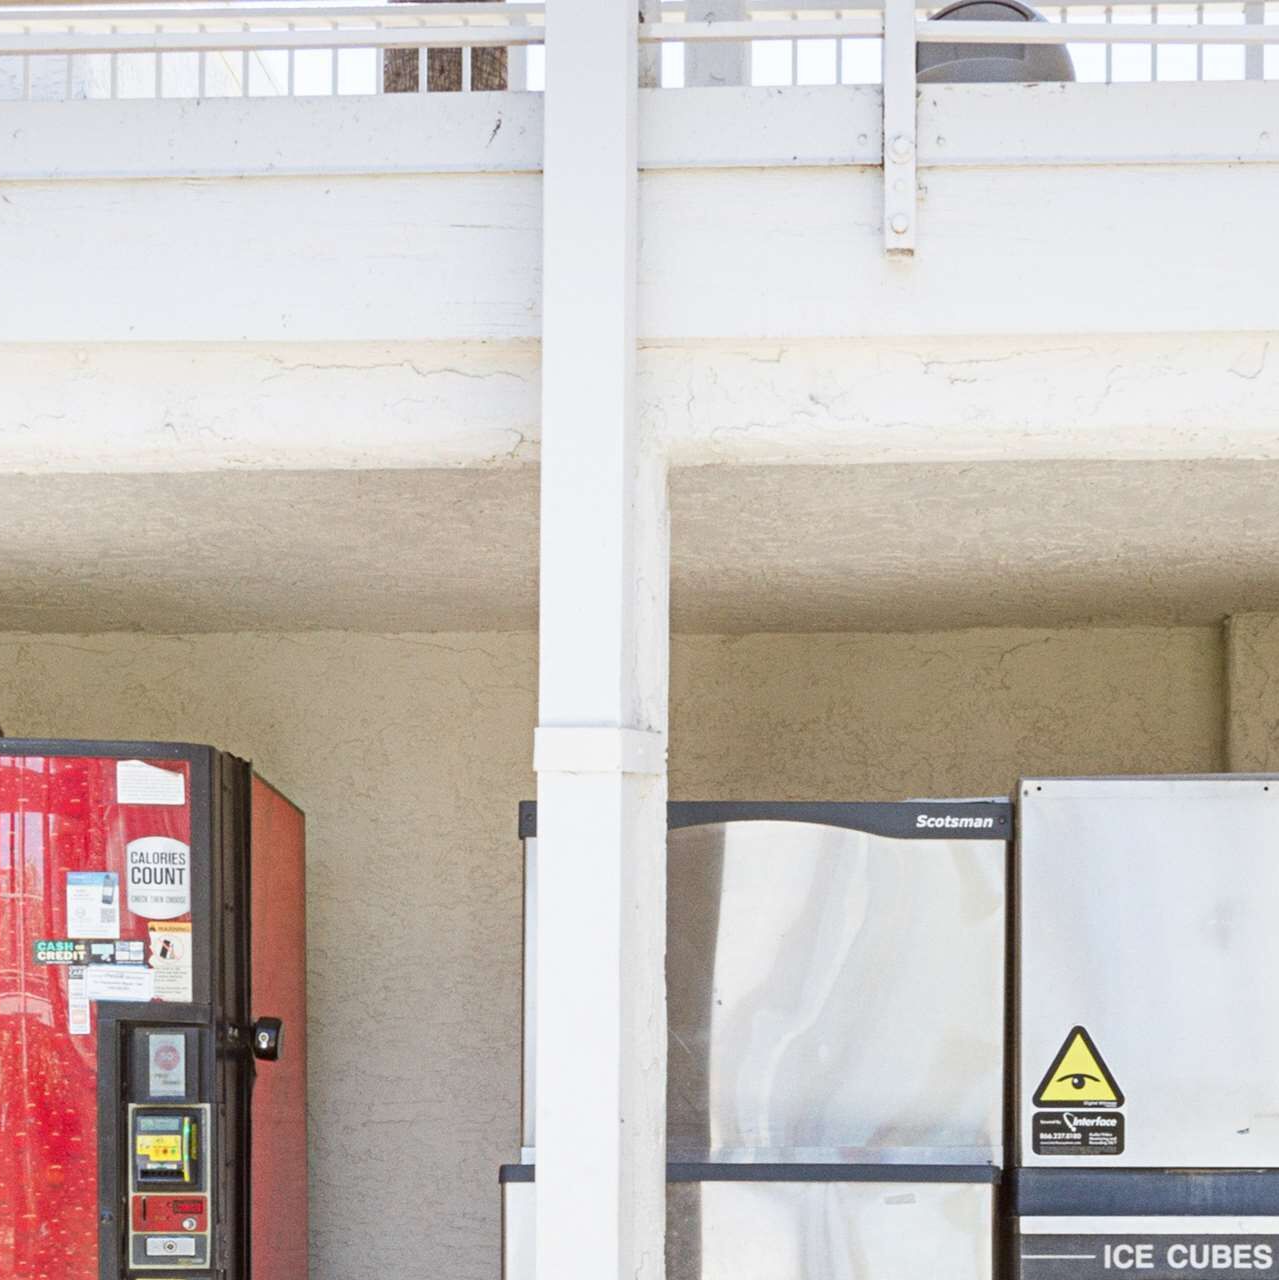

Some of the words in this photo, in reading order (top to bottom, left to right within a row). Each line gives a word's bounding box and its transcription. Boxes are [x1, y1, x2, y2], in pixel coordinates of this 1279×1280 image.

[915, 814, 994, 828] Scotsman
[130, 851, 186, 865] CALORIES
[130, 866, 186, 885] COUNT
[131, 895, 148, 903] CHECK
[36, 941, 74, 951] CASH
[37, 950, 87, 961] CREDIT
[1073, 1116, 1118, 1127] Interface
[1104, 1244, 1154, 1269] ICE
[1167, 1244, 1273, 1270] CUBES
